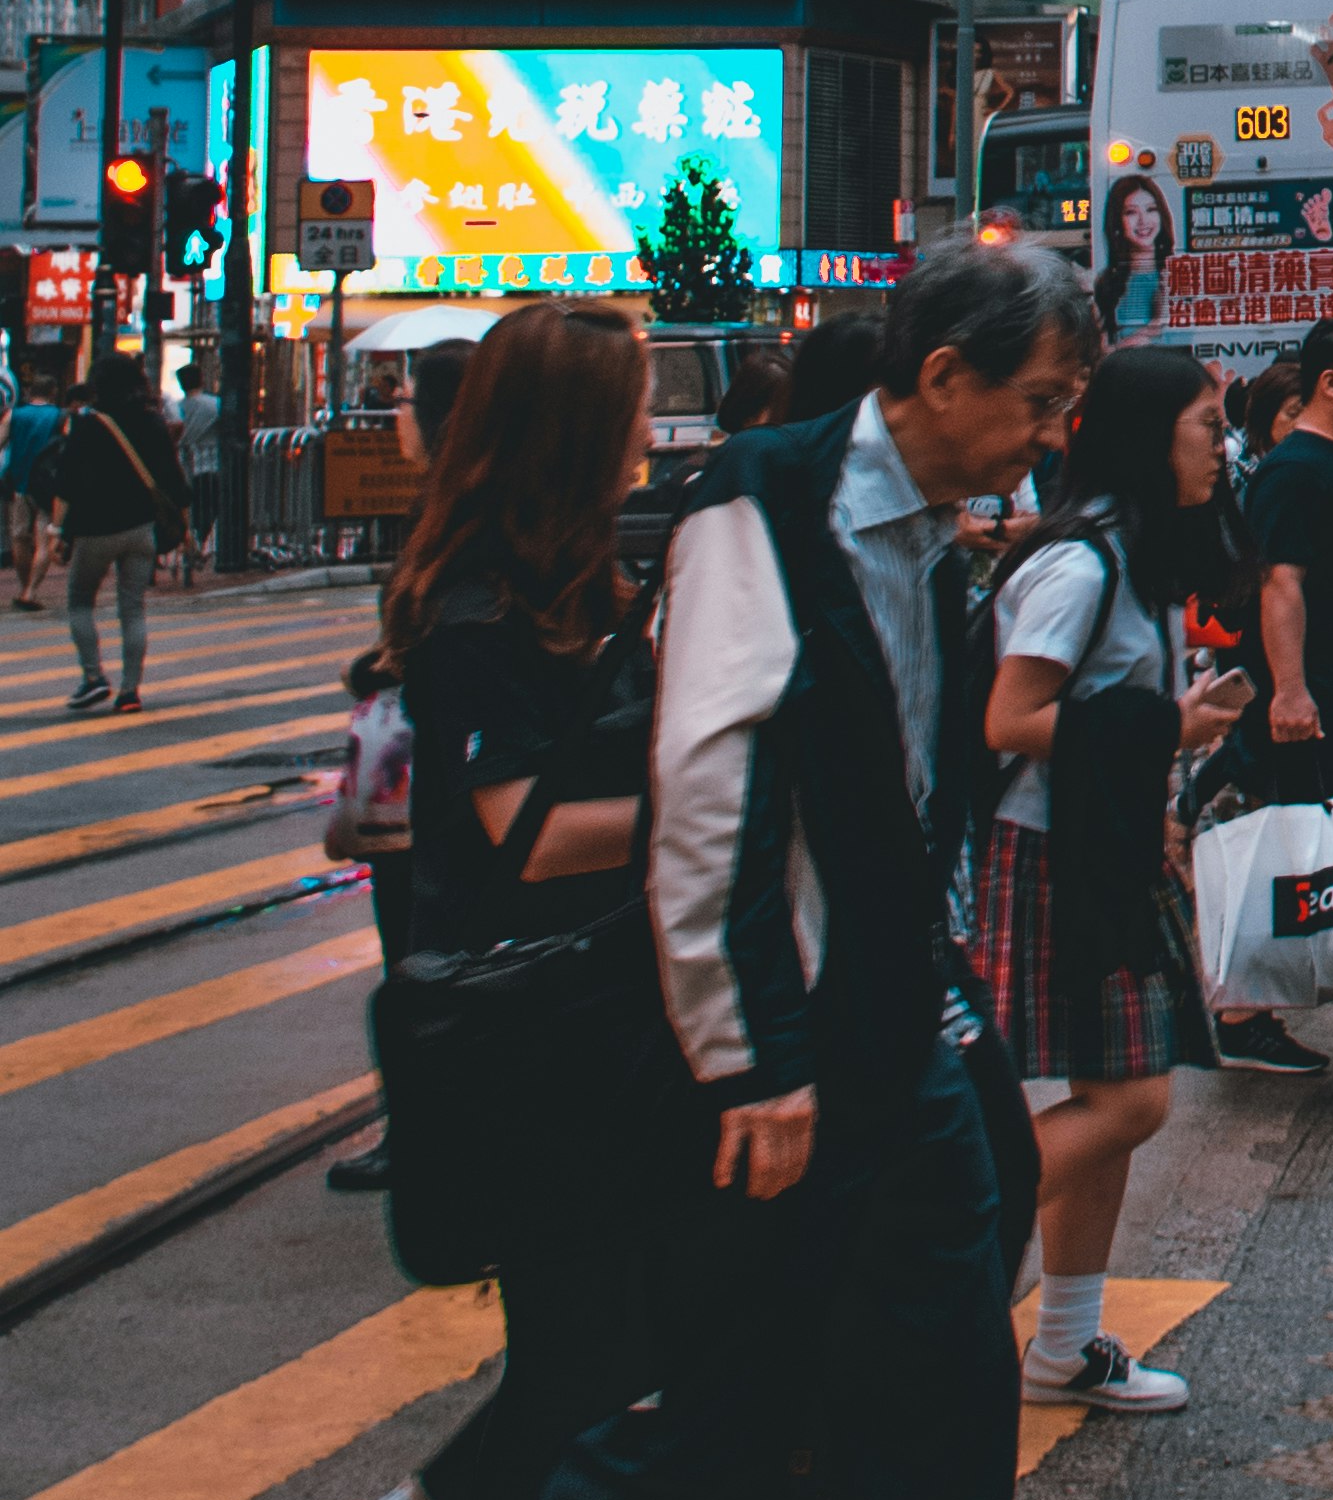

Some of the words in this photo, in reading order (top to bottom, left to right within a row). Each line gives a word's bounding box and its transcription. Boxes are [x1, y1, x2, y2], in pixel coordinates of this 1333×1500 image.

[1237, 106, 1288, 139] 603
[308, 225, 332, 241] 24
[337, 225, 364, 241] hrs
[314, 245, 358, 266] 全日
